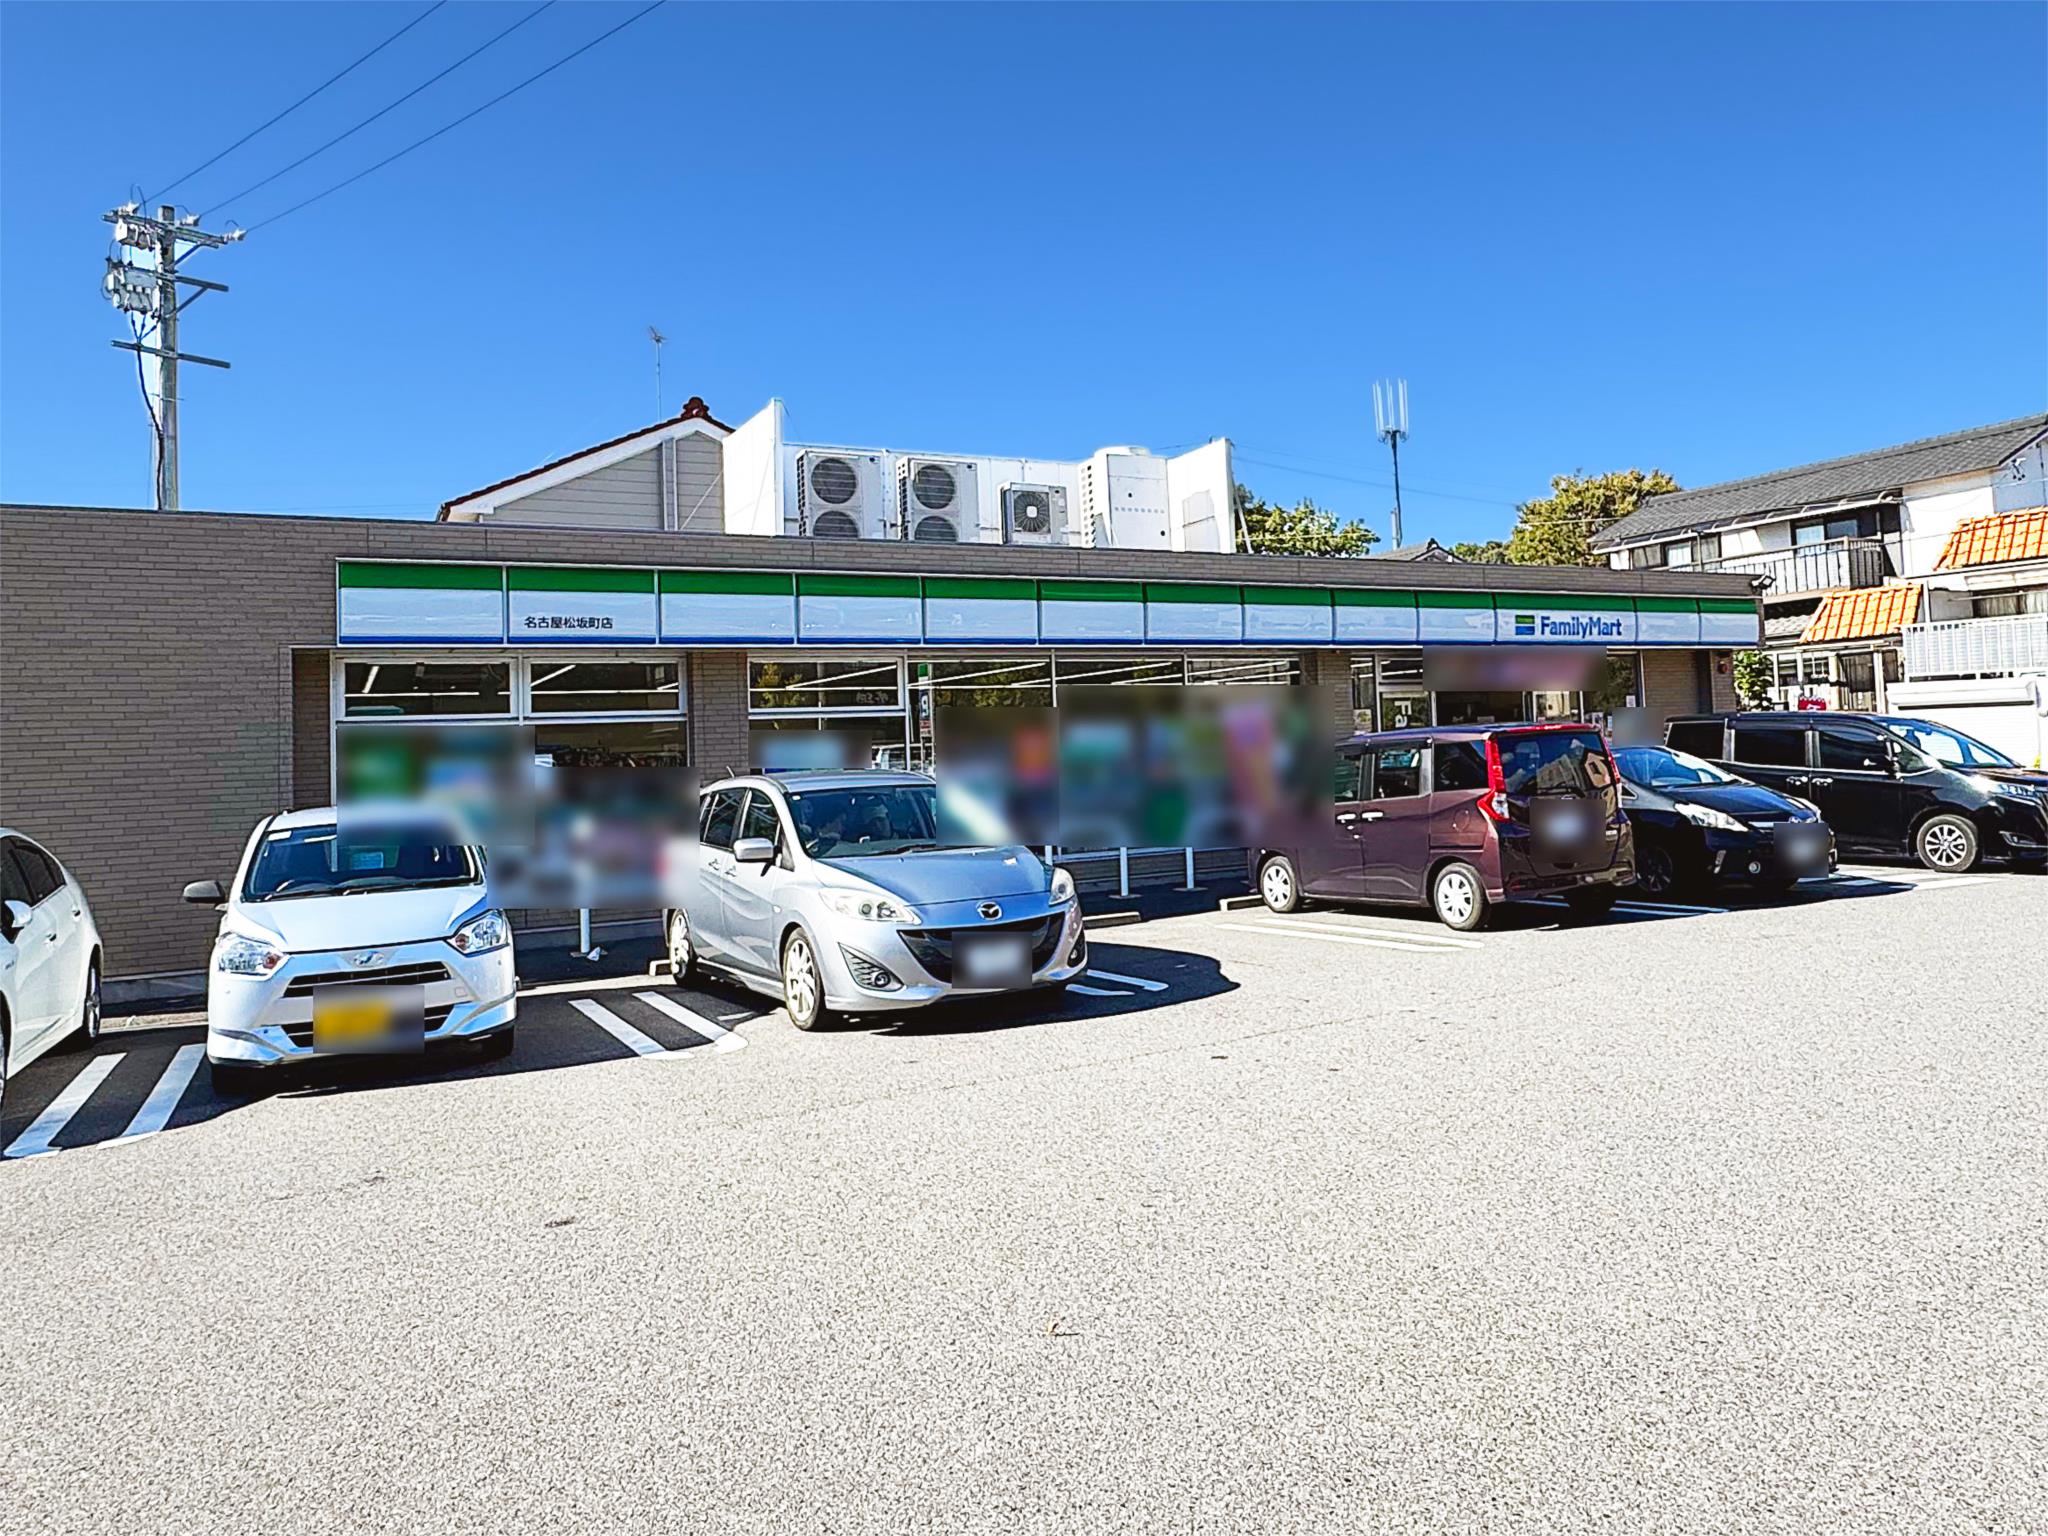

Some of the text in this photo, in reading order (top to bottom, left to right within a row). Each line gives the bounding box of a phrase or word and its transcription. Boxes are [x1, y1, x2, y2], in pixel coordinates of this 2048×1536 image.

[524, 616, 613, 629] 名古屋松坂町店
[1540, 616, 1622, 639] FamilyMart
